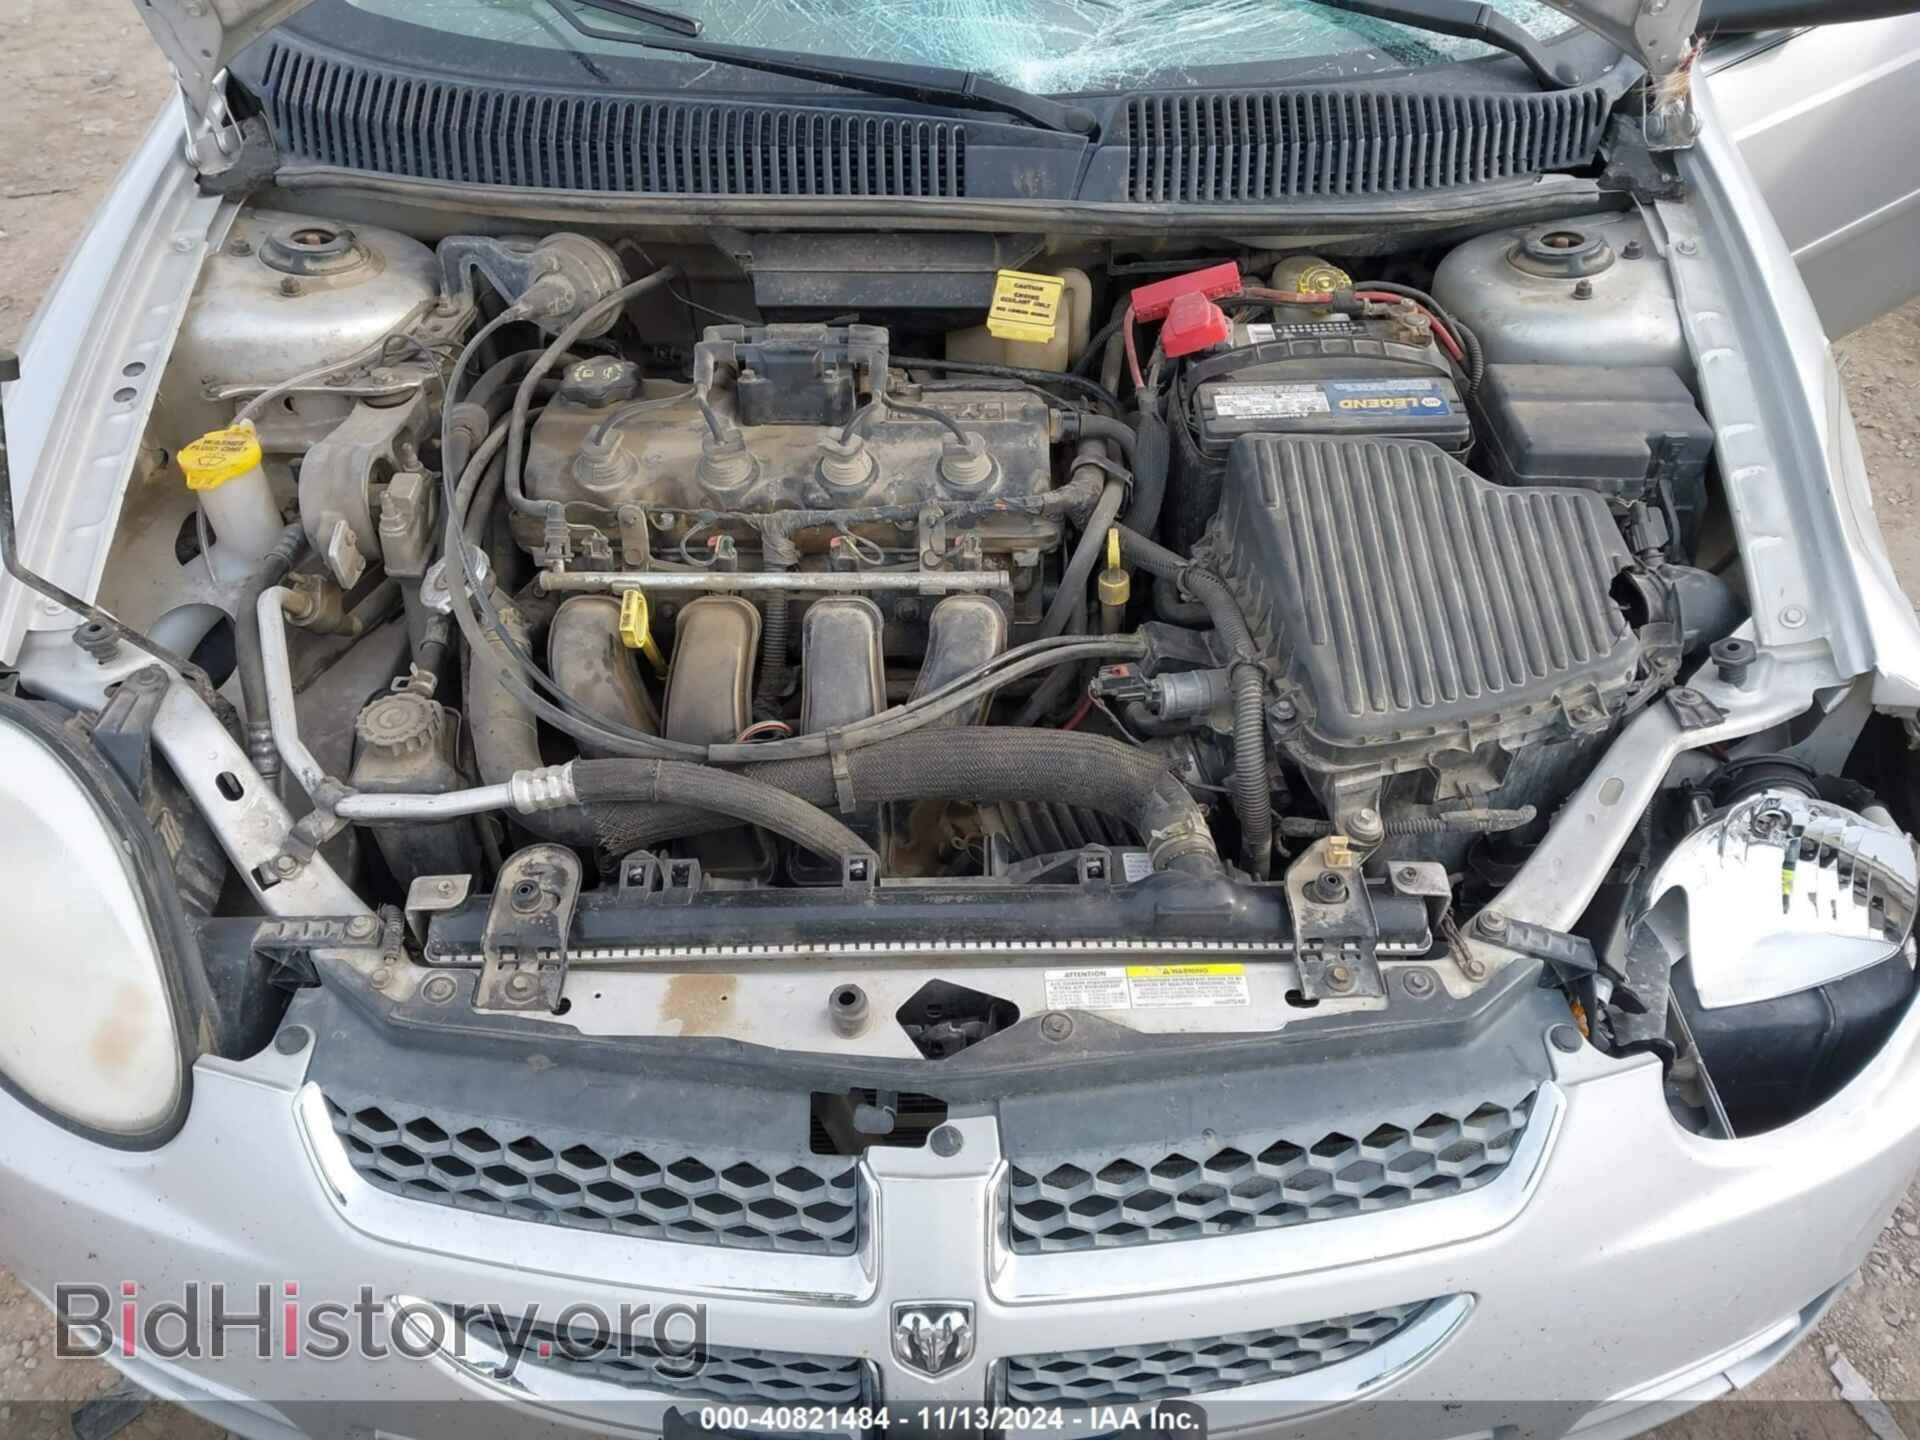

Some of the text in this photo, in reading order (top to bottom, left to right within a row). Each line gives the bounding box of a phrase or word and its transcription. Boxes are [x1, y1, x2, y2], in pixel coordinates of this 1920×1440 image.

[1014, 283, 1043, 291] CAUTION
[1339, 397, 1419, 409] LEGEND
[1063, 970, 1106, 978] ATTENTION
